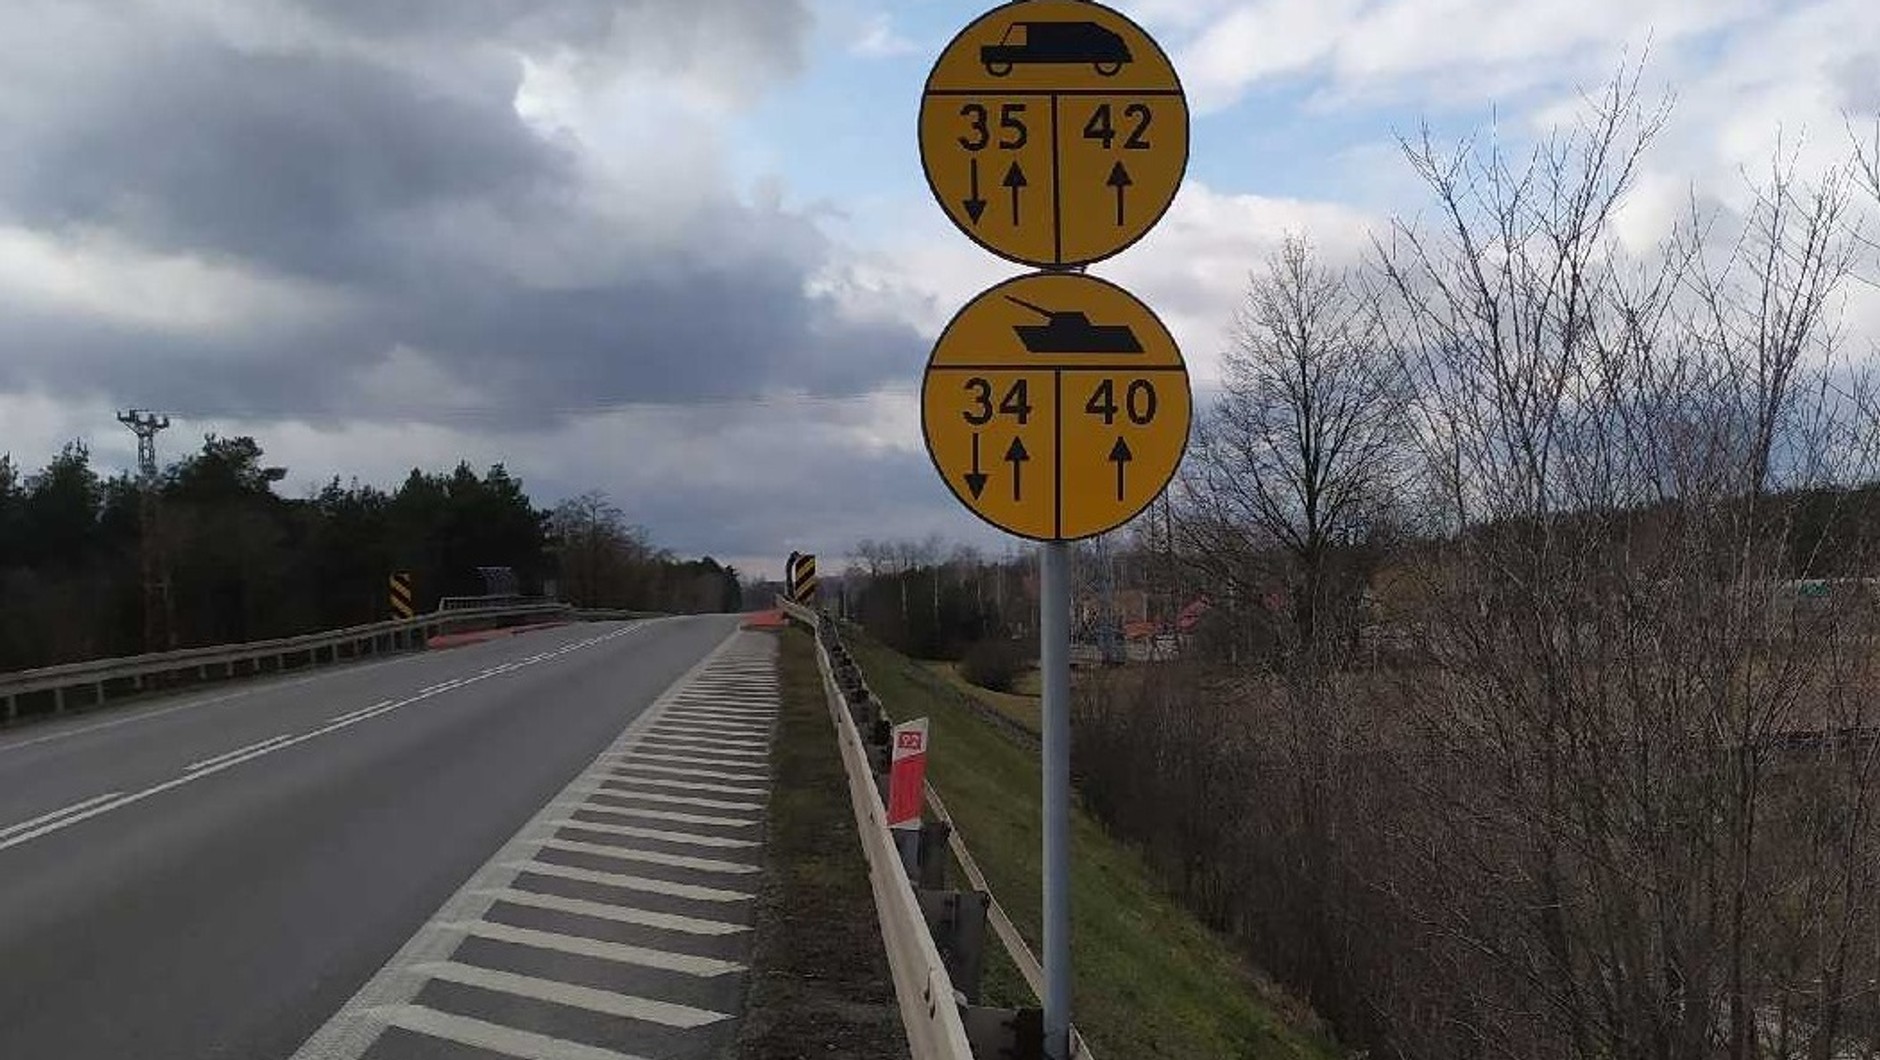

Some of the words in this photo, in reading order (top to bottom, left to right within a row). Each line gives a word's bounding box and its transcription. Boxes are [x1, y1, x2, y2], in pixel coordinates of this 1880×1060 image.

[957, 103, 1028, 151] 35
[1083, 104, 1152, 150] 42
[962, 378, 1032, 426] 34
[1085, 379, 1157, 425] 40
